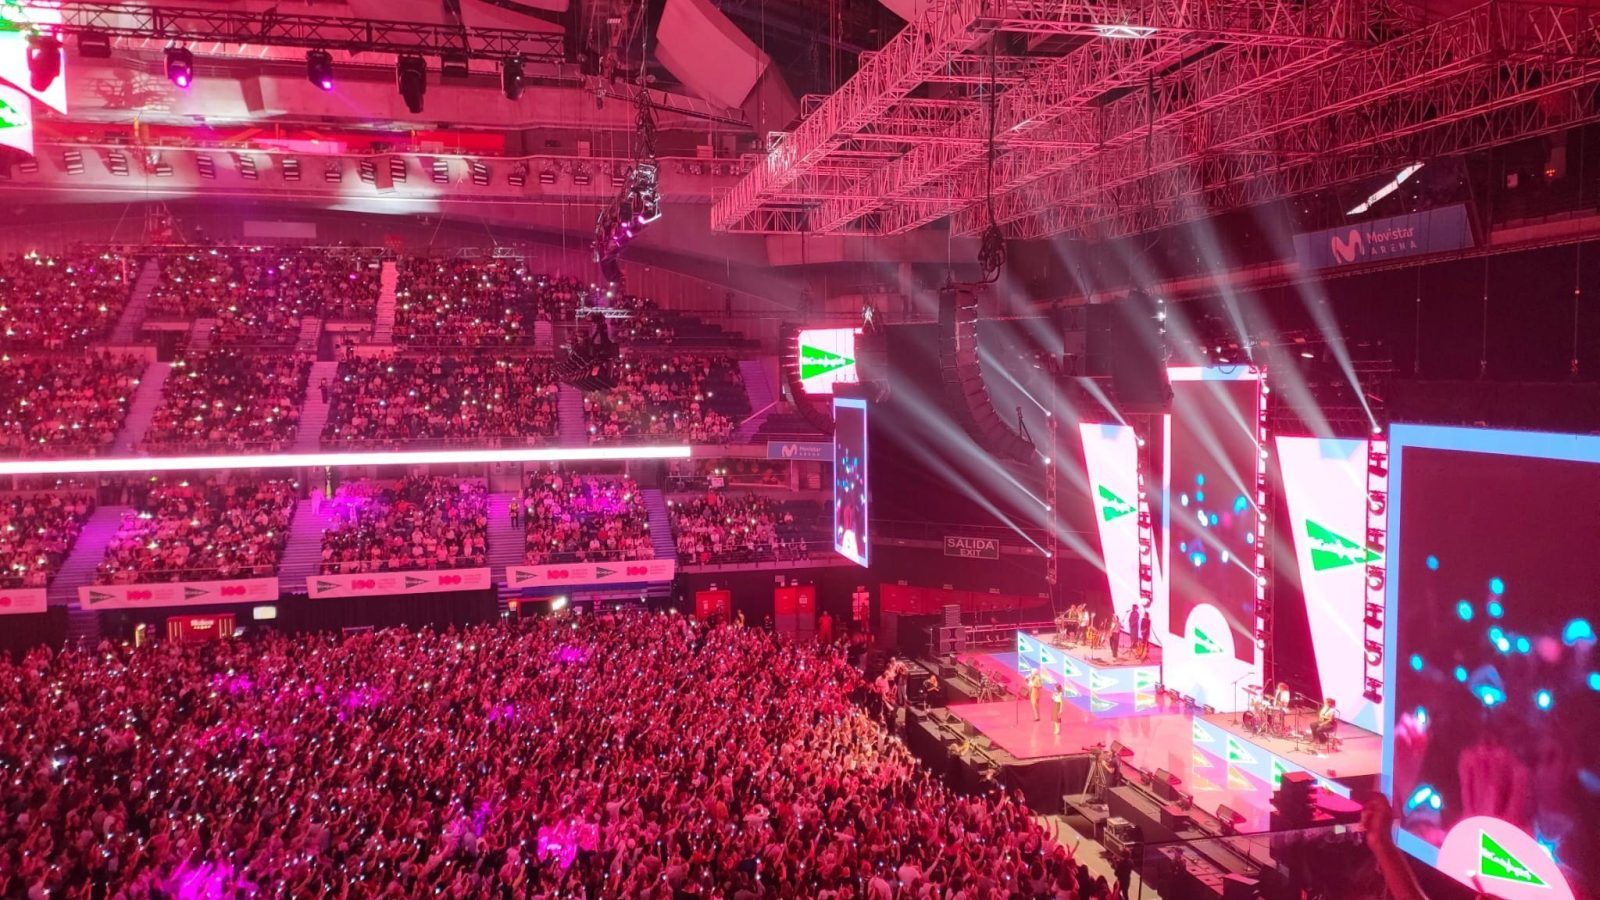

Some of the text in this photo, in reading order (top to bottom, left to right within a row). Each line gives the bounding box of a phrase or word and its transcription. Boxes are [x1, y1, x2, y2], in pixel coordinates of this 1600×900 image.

[1366, 227, 1415, 244] Movistar
[1371, 240, 1417, 255] ARENA
[947, 538, 995, 550] SALIDA
[960, 548, 982, 557] EXIT
